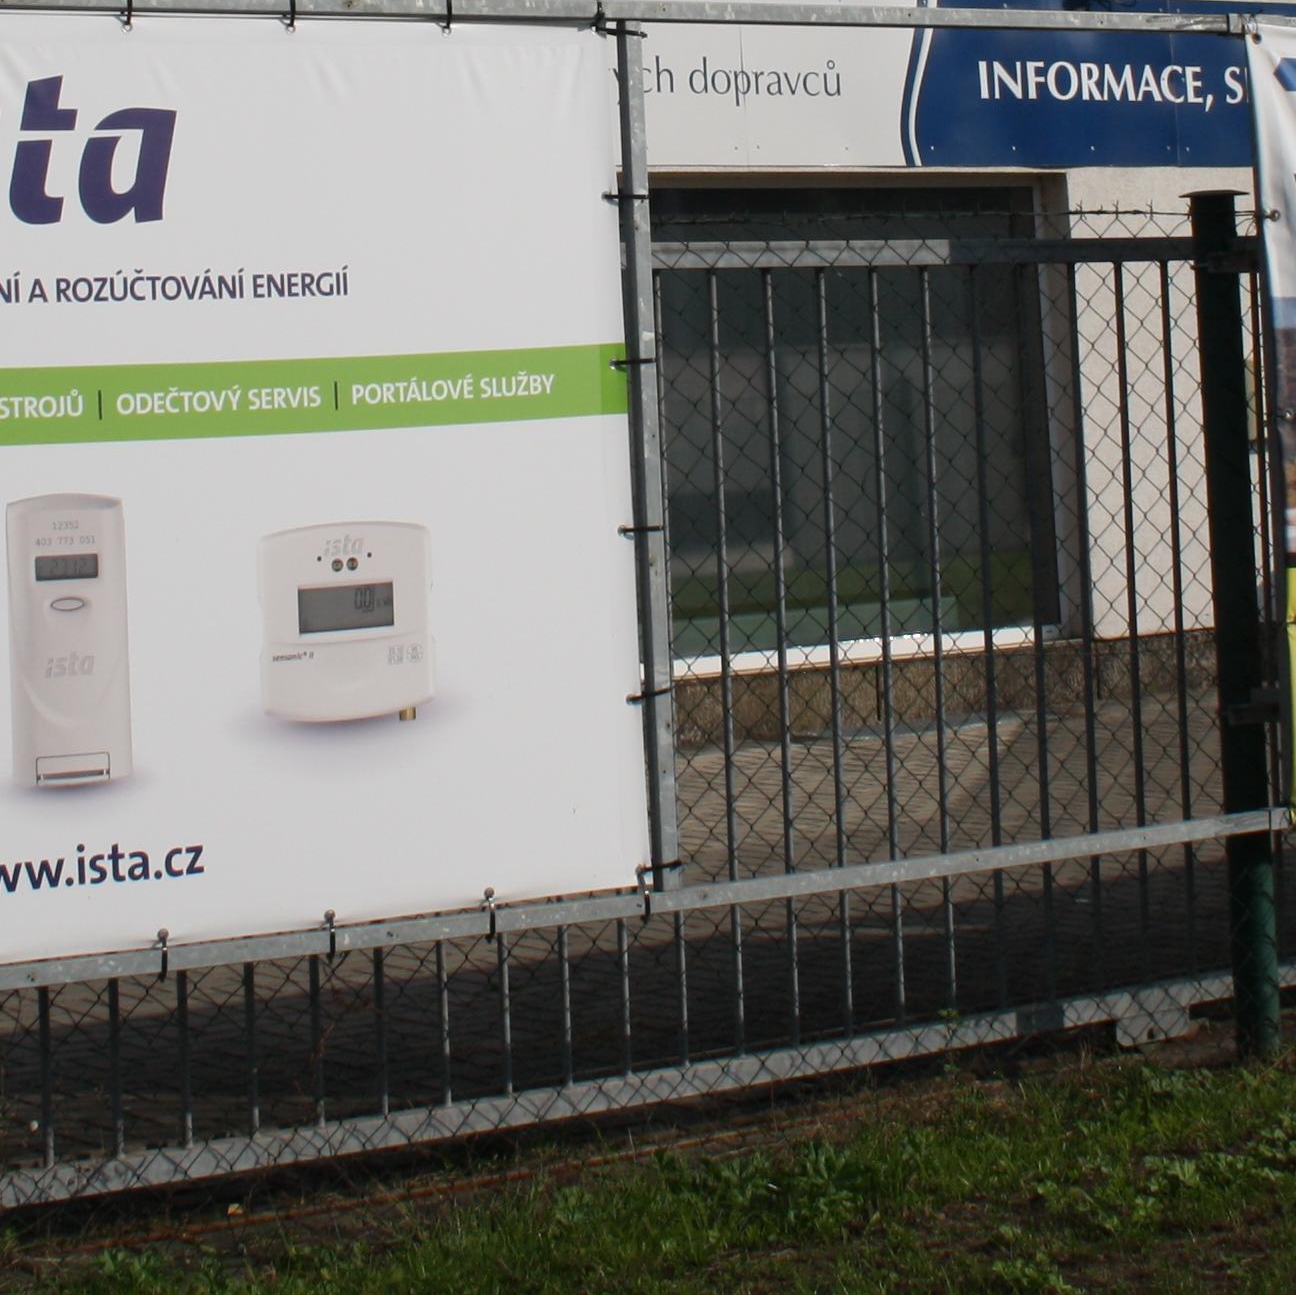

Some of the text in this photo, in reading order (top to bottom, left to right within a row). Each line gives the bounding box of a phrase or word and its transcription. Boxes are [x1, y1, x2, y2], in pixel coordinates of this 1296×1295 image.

[689, 56, 842, 107] dopravců
[977, 60, 1249, 113] INFORMACE, S
[28, 278, 48, 303] A
[57, 267, 245, 303] ROZÚČTOVÁNÍ
[252, 265, 350, 299] ENERGIÍ
[116, 383, 242, 416] ODEČTOVÝ
[248, 385, 322, 411] SERVIS
[351, 373, 474, 406] PORTÁLOVÉ
[479, 373, 555, 399] SLUŽBY
[324, 534, 365, 557] ista
[45, 651, 95, 679] ista
